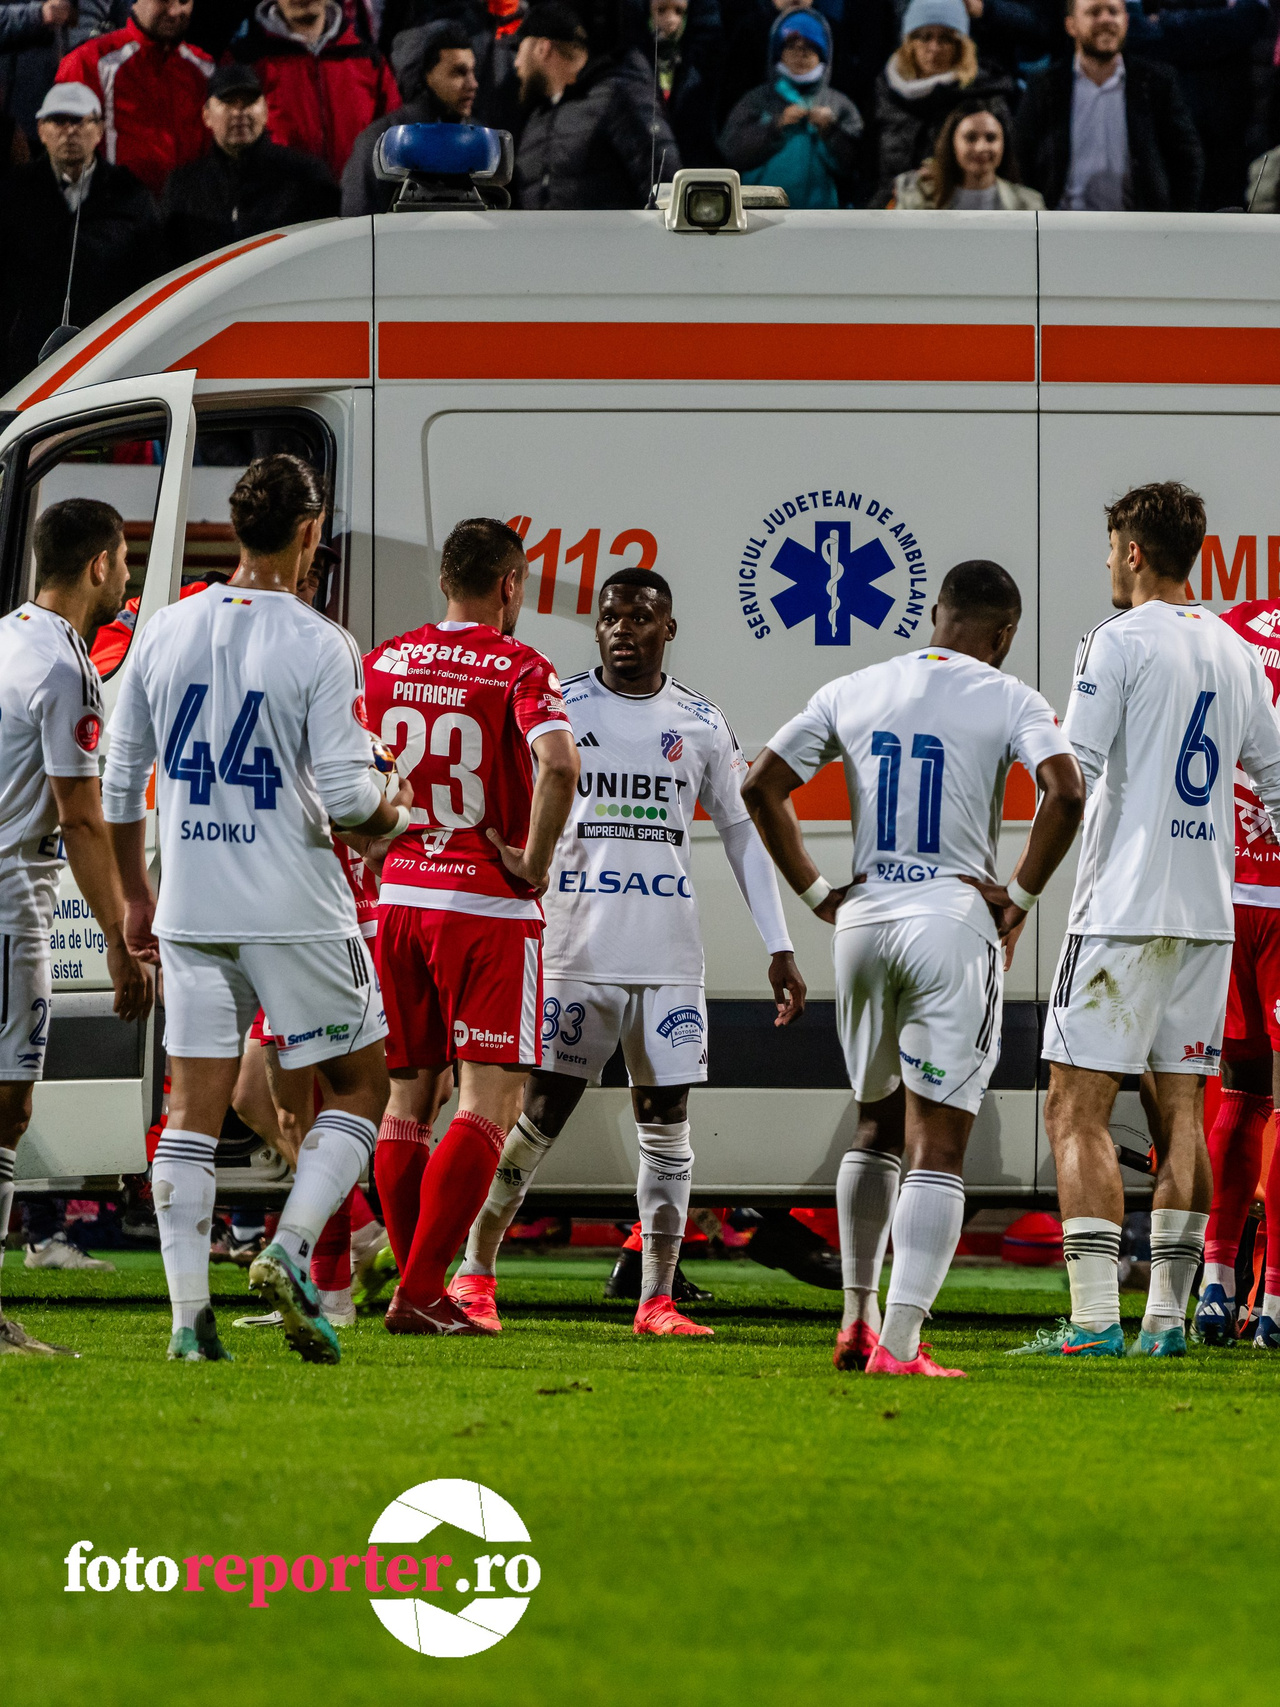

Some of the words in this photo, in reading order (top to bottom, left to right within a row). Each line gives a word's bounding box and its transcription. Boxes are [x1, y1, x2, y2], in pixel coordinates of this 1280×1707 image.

[738, 537, 771, 640] SERVICIUL
[762, 489, 863, 535] JUDETEAN
[865, 499, 894, 526] DE
[888, 522, 927, 640] AMBULANTA
[399, 642, 512, 671] Regata.ro
[407, 667, 431, 676] Gresie
[474, 676, 509, 688] Parchet
[393, 681, 468, 707] PATRICHE
[164, 683, 284, 810] 44
[1174, 690, 1219, 807] 6
[381, 706, 486, 828] 23
[576, 771, 687, 805] UNIBET
[871, 730, 945, 854] 11
[181, 820, 256, 844] SADIKU
[637, 827, 665, 842] SPRE
[419, 861, 477, 876] GAMING
[50, 929, 66, 950] ala
[68, 929, 82, 949] de
[542, 997, 586, 1046] 83
[659, 1019, 674, 1035] FIVE
[287, 1026, 324, 1046] Smart
[325, 1023, 349, 1036] Eco
[330, 1033, 350, 1043] Plus
[469, 1027, 515, 1045] Tehnic
[556, 1050, 587, 1065] Vestra
[921, 1061, 947, 1078] Eco
[922, 1073, 943, 1086] Plus
